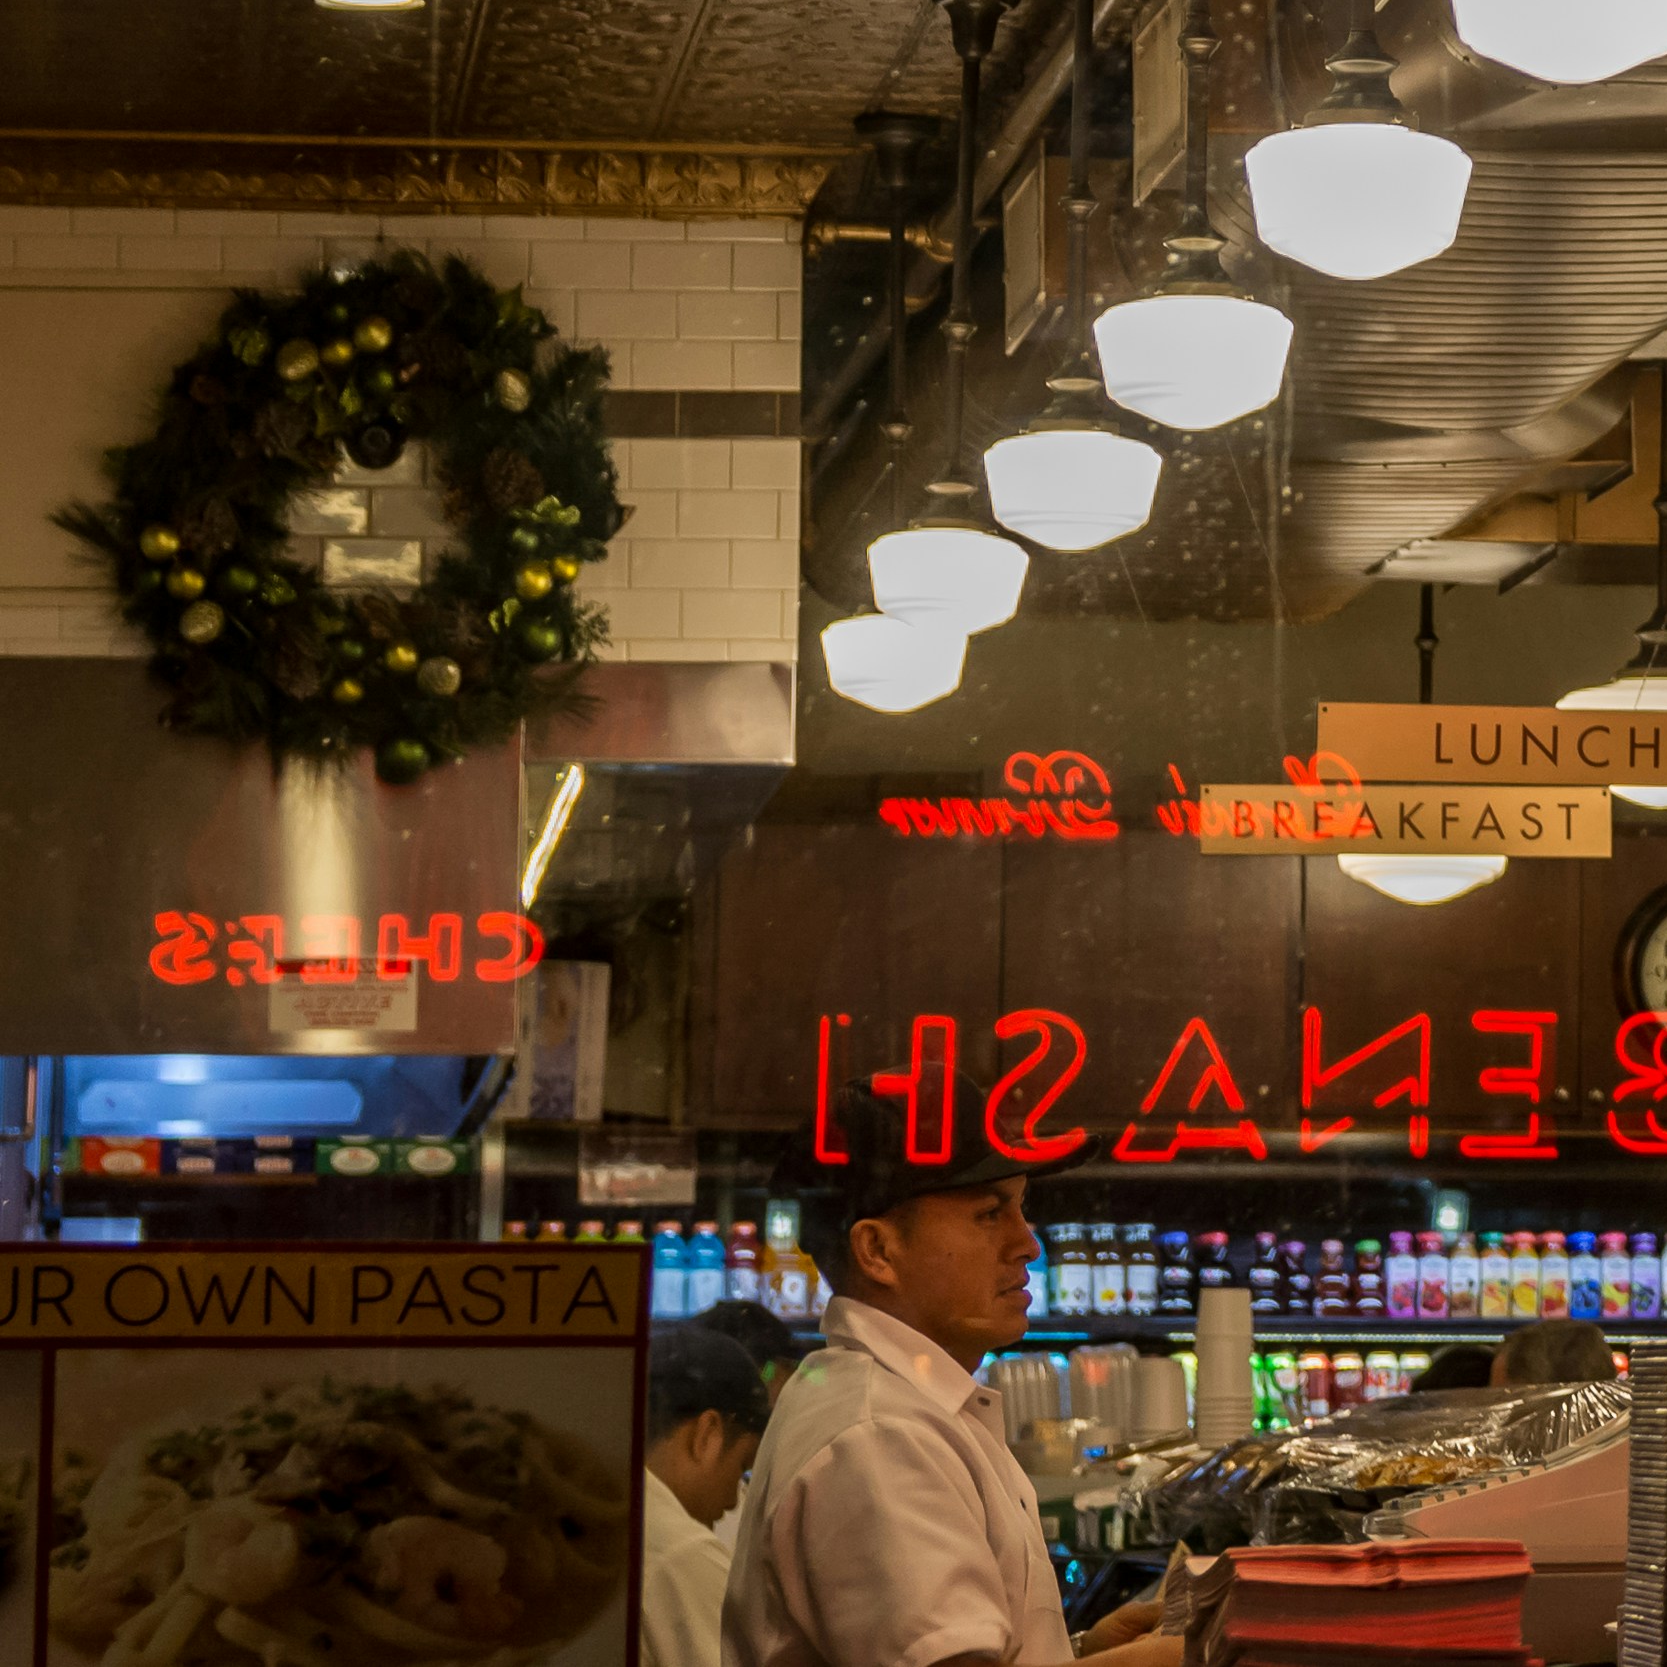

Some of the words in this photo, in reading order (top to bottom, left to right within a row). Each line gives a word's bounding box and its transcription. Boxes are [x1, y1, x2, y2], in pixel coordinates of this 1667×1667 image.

[1433, 722, 1662, 770] LUNCH
[1233, 802, 1581, 841] BREAKFAST
[103, 1264, 317, 1327] OWN
[350, 1265, 619, 1327] PASTA
